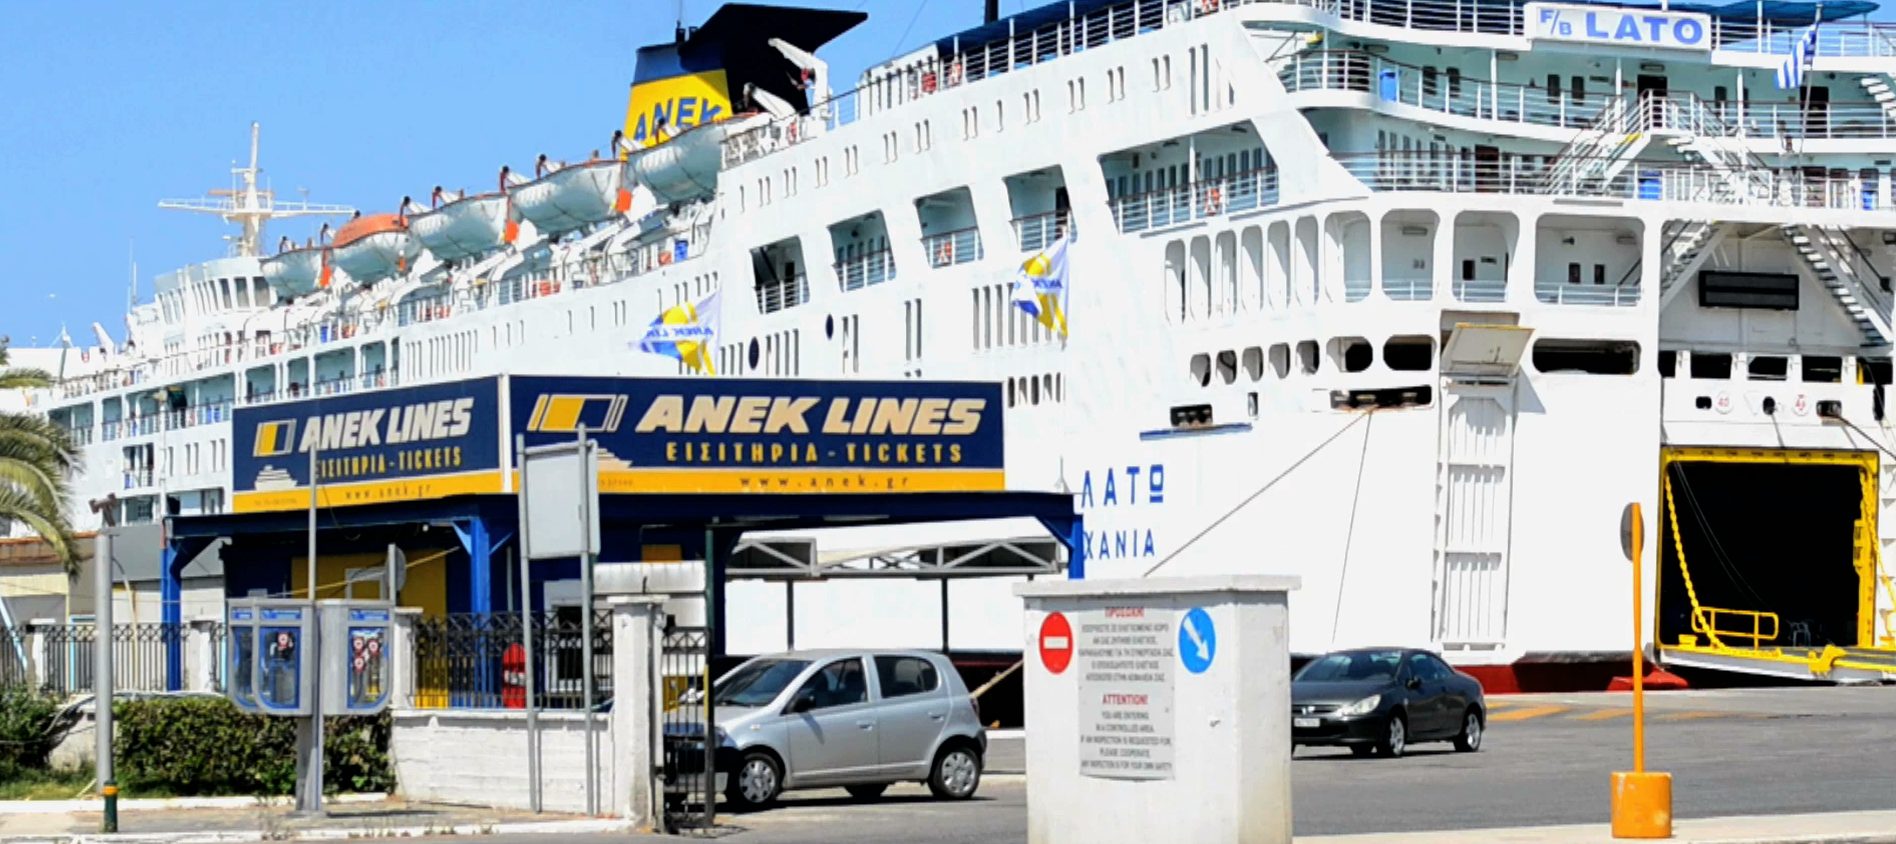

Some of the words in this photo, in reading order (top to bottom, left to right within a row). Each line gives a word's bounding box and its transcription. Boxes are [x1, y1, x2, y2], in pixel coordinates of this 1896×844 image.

[1540, 9, 1573, 36] F/B
[1586, 11, 1703, 45] LATO
[632, 96, 722, 142] ANEK
[299, 407, 389, 453] ANEK
[385, 396, 475, 443] LINES
[635, 394, 823, 435] ANEK
[821, 396, 988, 436] LINES
[399, 446, 463, 472] TICKETS
[846, 442, 963, 463] TICKETS
[739, 475, 911, 491] www.anek.gr
[1102, 694, 1149, 705] ATTENTION!
